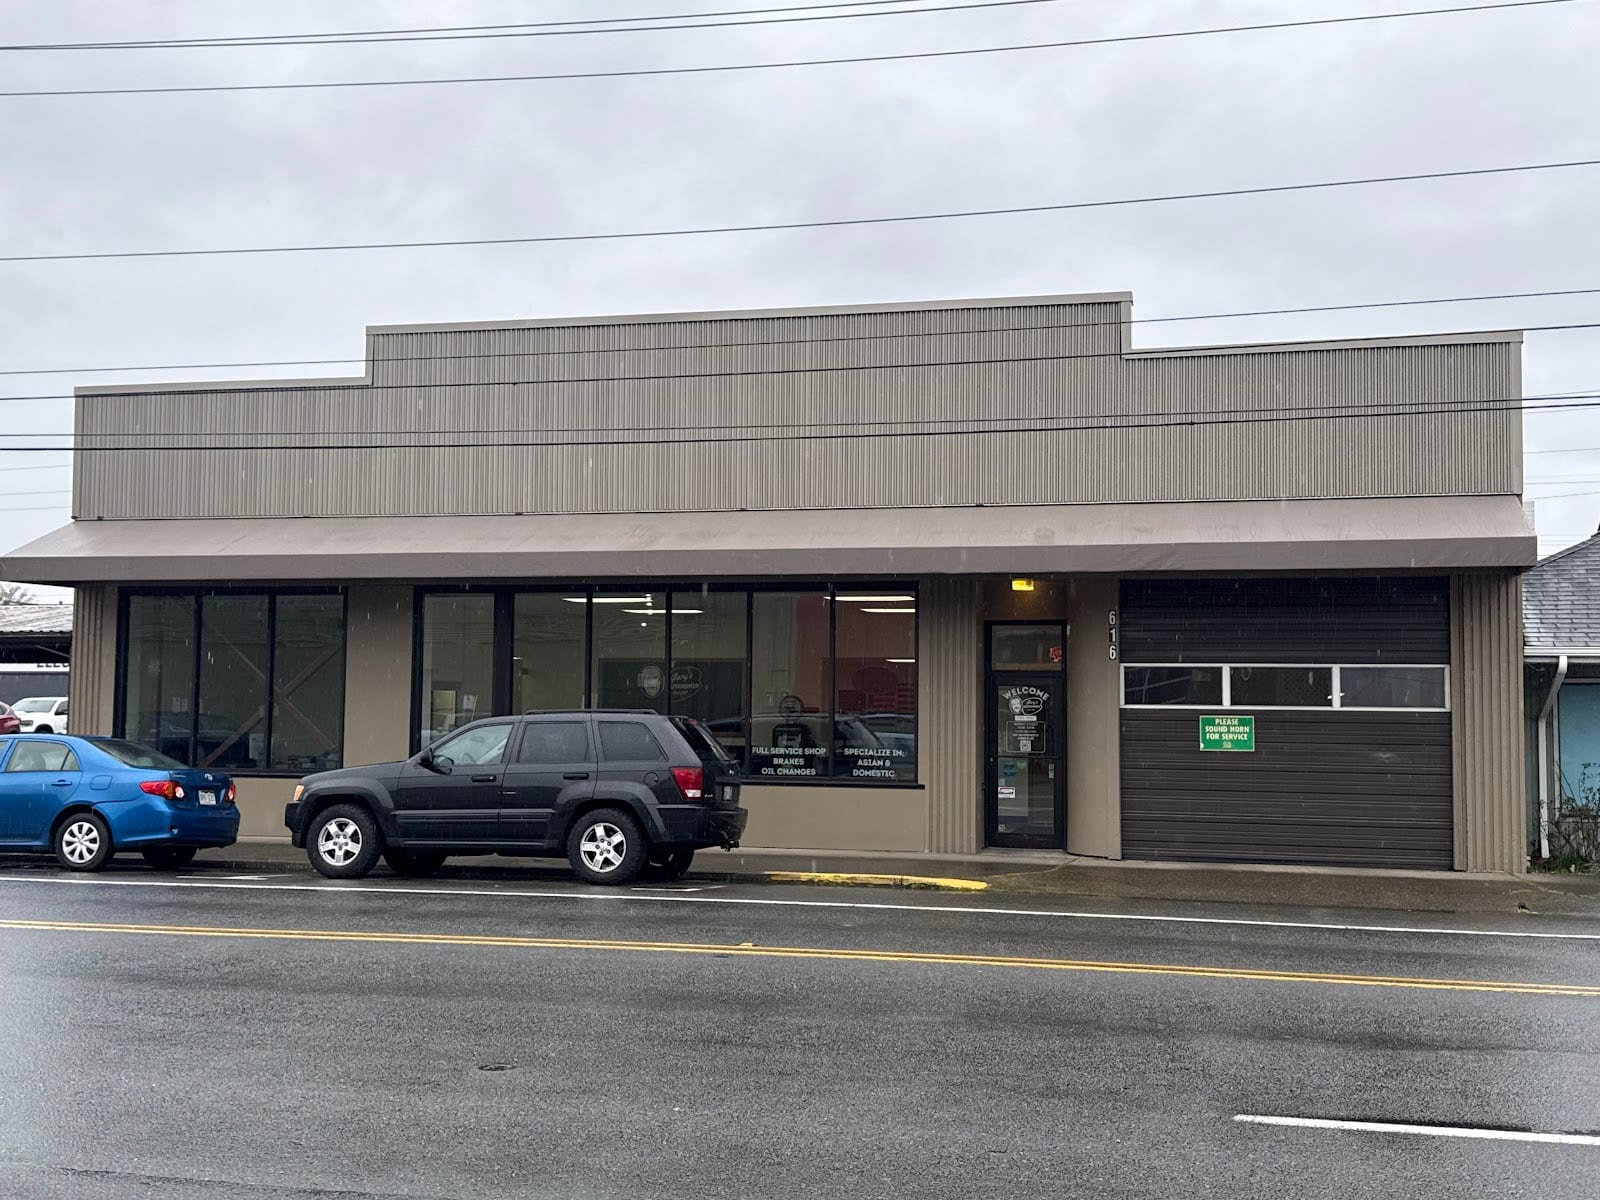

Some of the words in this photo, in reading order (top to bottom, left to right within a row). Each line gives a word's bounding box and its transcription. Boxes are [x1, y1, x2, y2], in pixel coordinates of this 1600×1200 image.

[1108, 610, 1117, 660] 616
[1002, 686, 1050, 701] WELCOME
[1205, 725, 1228, 733] SOUND
[1229, 725, 1249, 733] HORN
[1222, 733, 1248, 741] SERVICE
[770, 747, 804, 755] SERVICE
[804, 747, 826, 755] SHOP
[843, 748, 891, 756] SPECIALIZE
[773, 757, 805, 765] BRAKES
[857, 758, 883, 767] ASIAN
[761, 767, 776, 775] OIL
[777, 767, 816, 776] CHANGES
[852, 768, 896, 777] DOMESTIC
